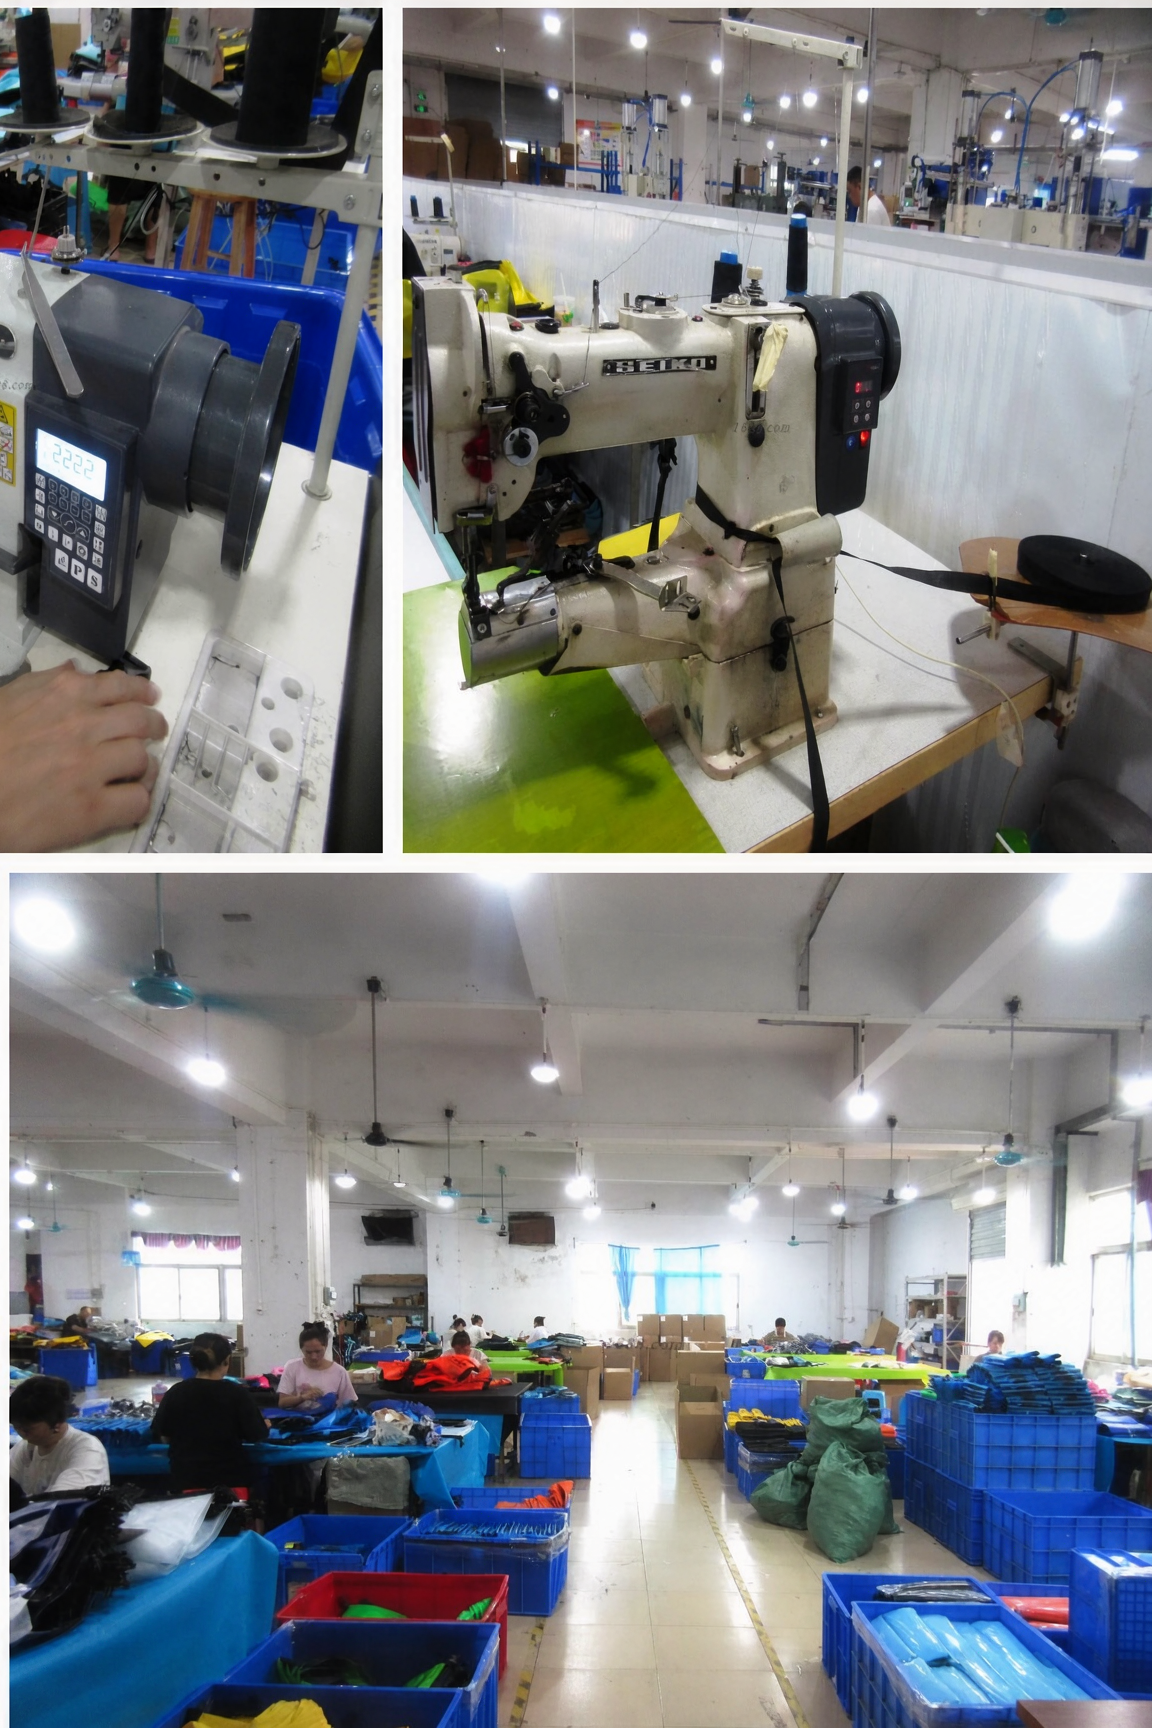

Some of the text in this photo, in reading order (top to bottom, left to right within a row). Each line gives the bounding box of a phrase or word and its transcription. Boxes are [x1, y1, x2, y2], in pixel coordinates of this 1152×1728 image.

[615, 358, 706, 373] SEIKO
[52, 443, 95, 480] 2222
[73, 564, 83, 577] P
[90, 574, 99, 588] S
